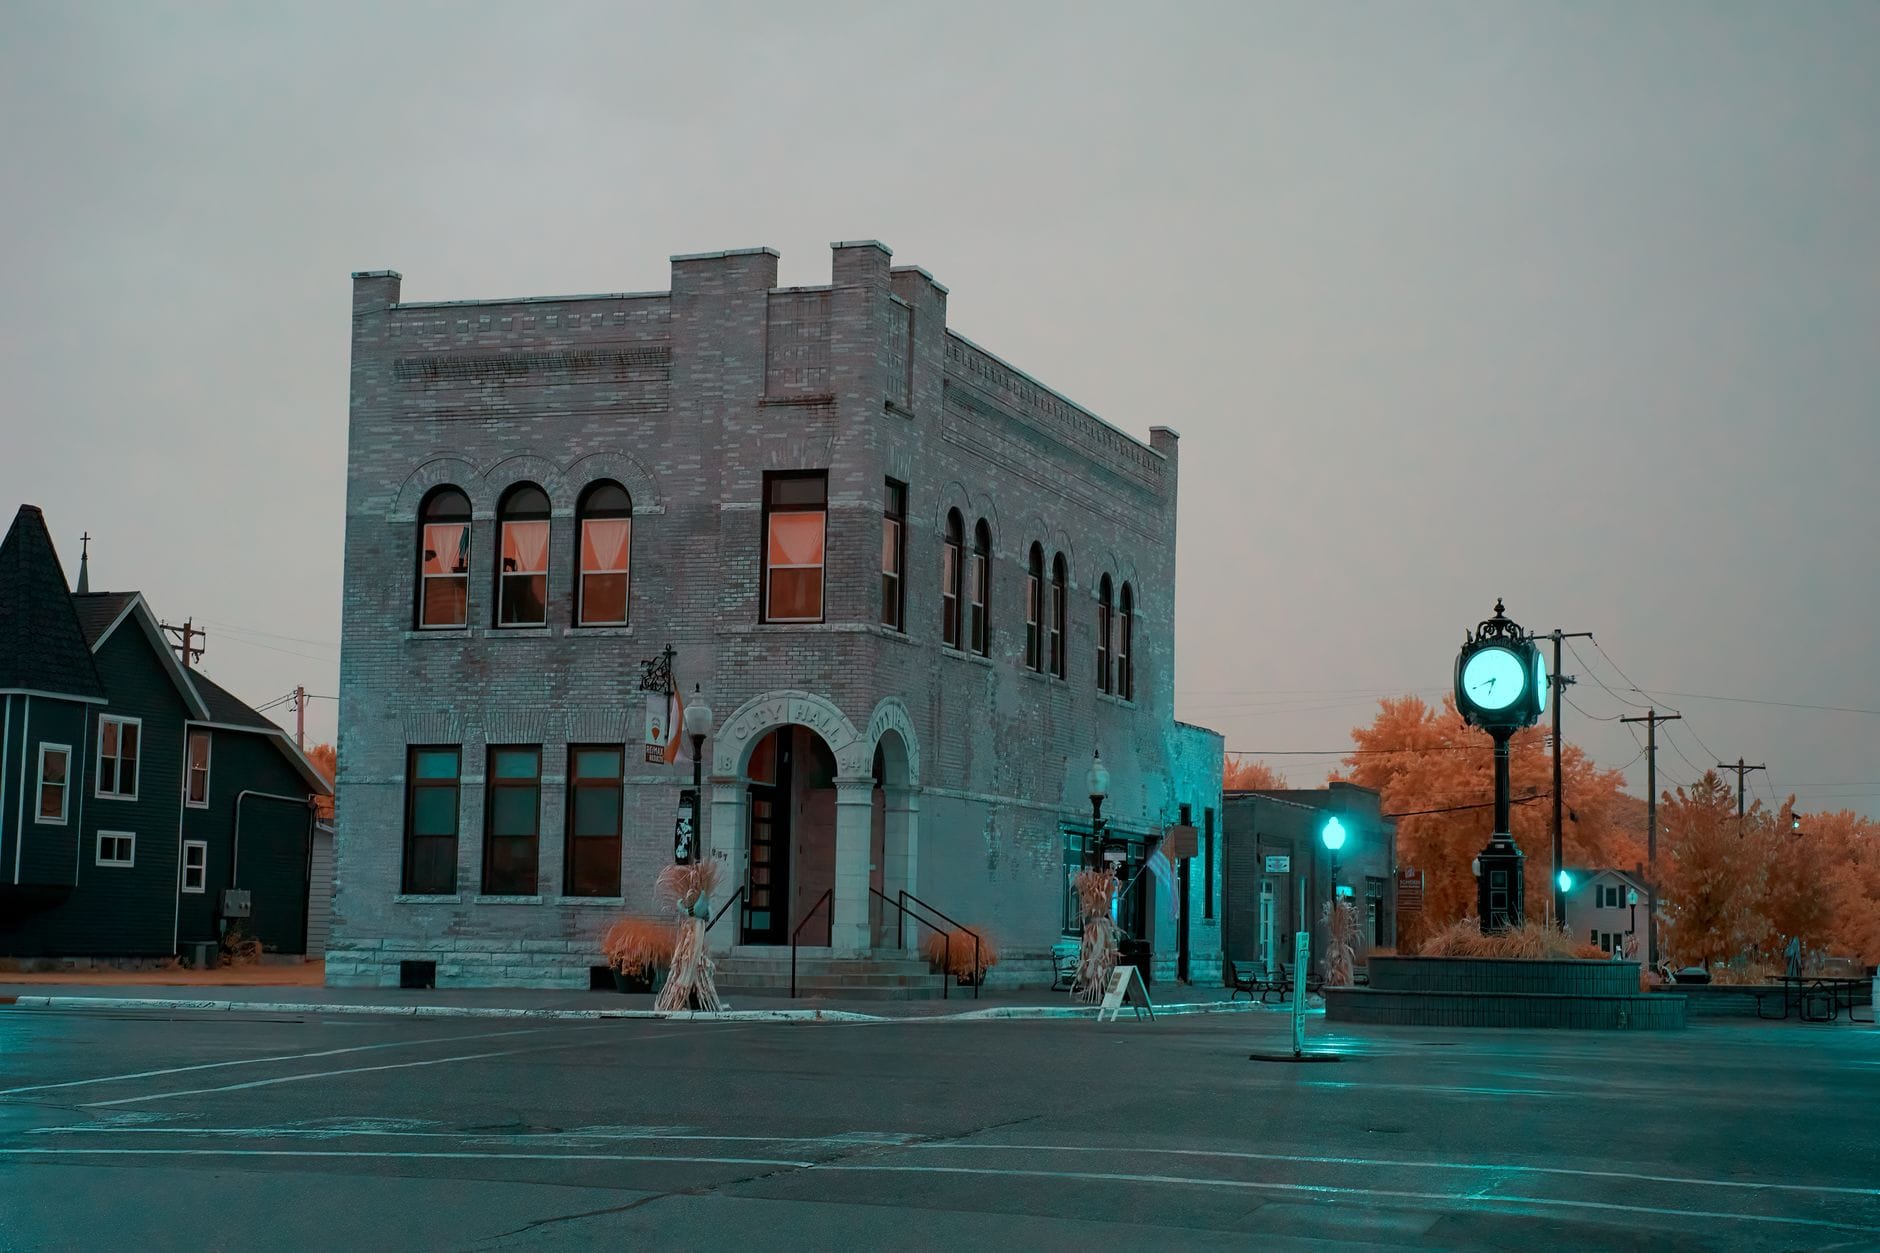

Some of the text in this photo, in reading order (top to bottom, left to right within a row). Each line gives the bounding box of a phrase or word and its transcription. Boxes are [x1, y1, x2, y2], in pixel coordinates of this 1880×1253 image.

[735, 704, 840, 744] CITY HALL
[717, 755, 733, 772] 18
